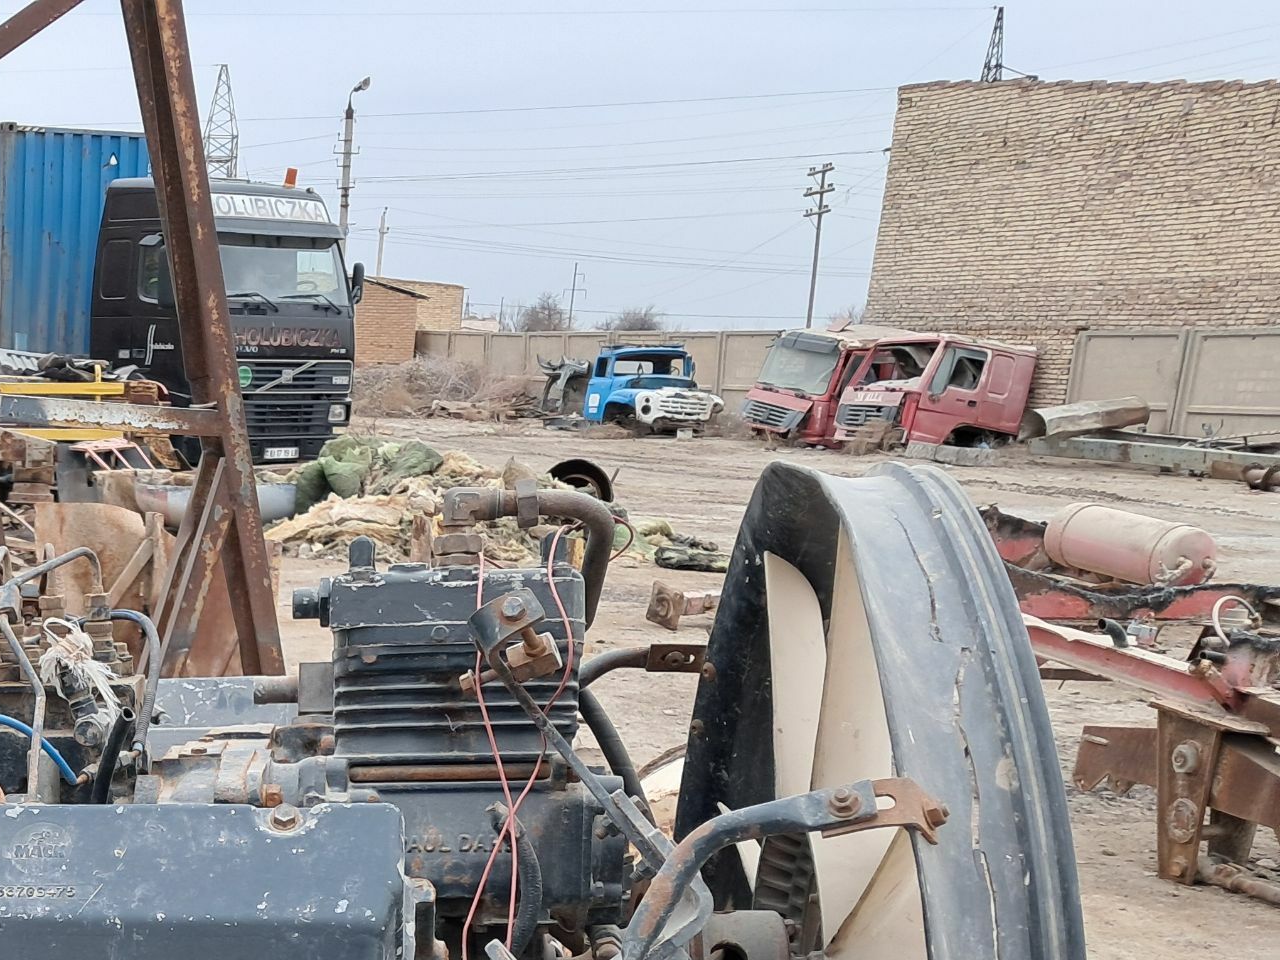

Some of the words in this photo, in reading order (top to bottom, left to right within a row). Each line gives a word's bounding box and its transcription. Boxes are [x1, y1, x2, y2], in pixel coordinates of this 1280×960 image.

[214, 195, 325, 221] OLUBICZKA
[234, 327, 342, 347] HOLUBICZKA
[235, 345, 259, 353] OLVO
[13, 844, 67, 859] MACK
